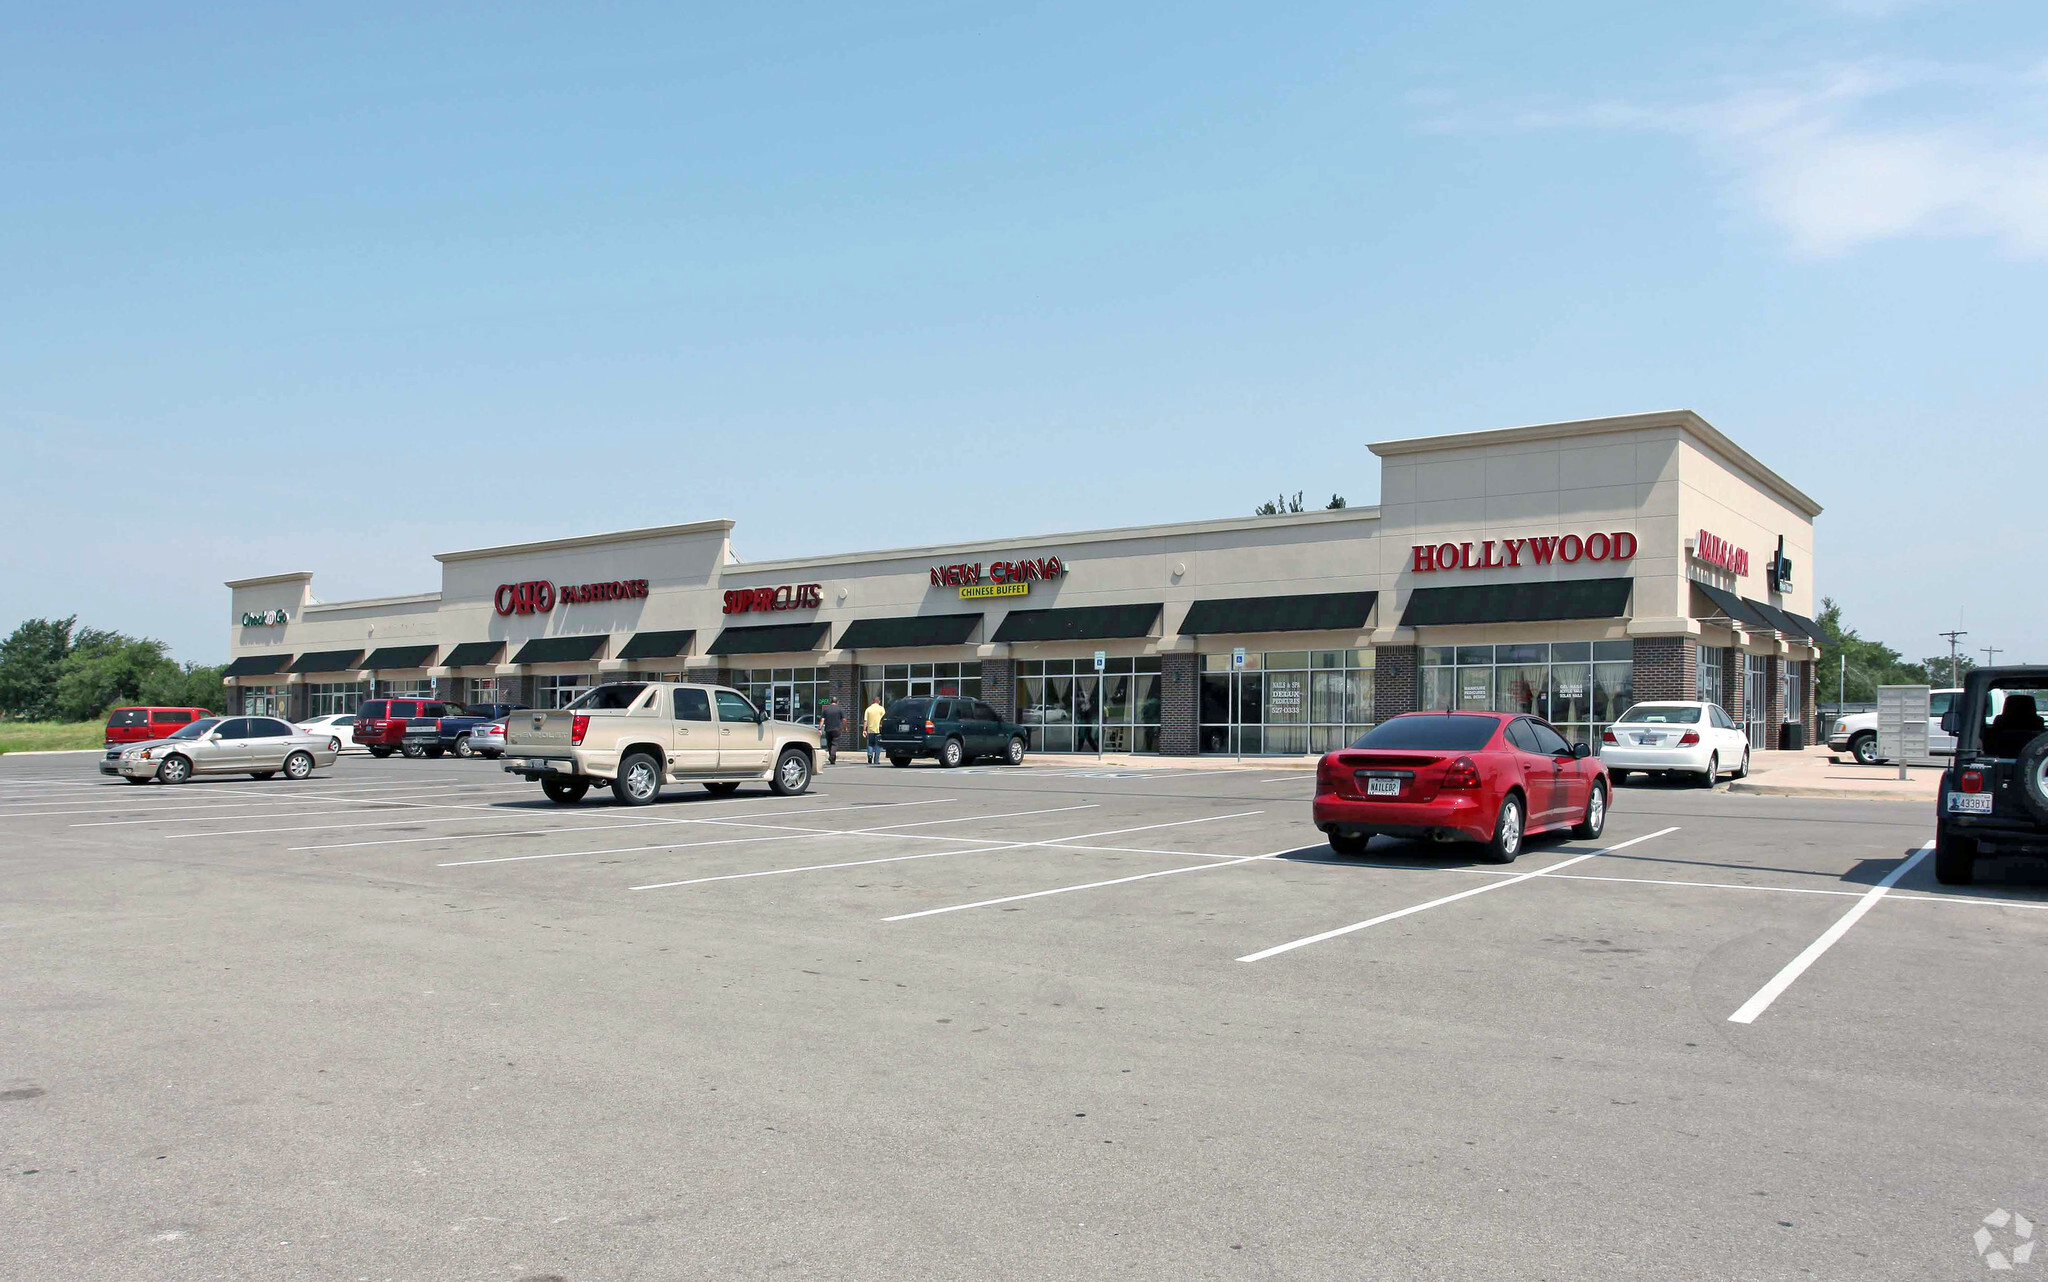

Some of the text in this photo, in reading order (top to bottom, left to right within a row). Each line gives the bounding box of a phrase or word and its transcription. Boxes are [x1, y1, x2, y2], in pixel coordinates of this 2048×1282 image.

[1411, 531, 1638, 573] HOLLYWOOD
[1698, 529, 1749, 577] NAILS & SPA
[930, 555, 1063, 587] NEW CHINA
[495, 578, 649, 616] CATO FASHIONS
[722, 583, 823, 614] SUPERCUTS
[961, 584, 1026, 597] CHINESE BUFFET
[510, 731, 569, 740] CHEVROLET
